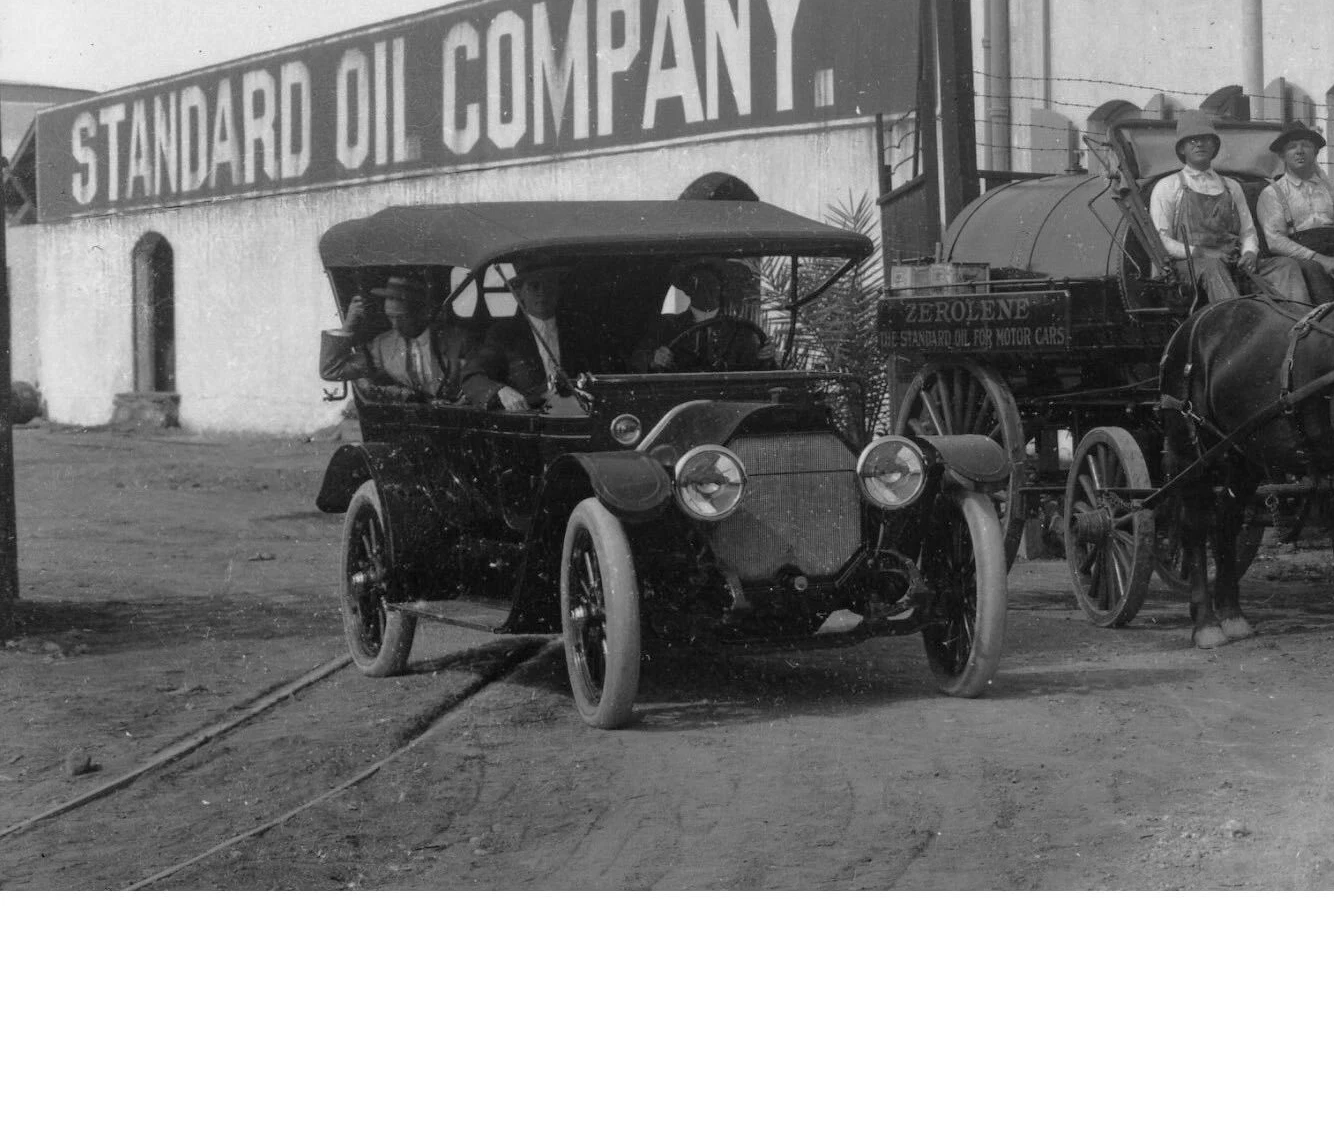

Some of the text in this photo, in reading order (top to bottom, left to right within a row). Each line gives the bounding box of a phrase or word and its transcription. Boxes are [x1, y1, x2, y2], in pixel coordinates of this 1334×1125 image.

[71, 61, 312, 206] STANDARD
[335, 38, 421, 170] OIL
[905, 298, 1030, 323] ZEROLENE
[880, 326, 1065, 348] THE STANDARD OIL FOR MOTOR CARS
